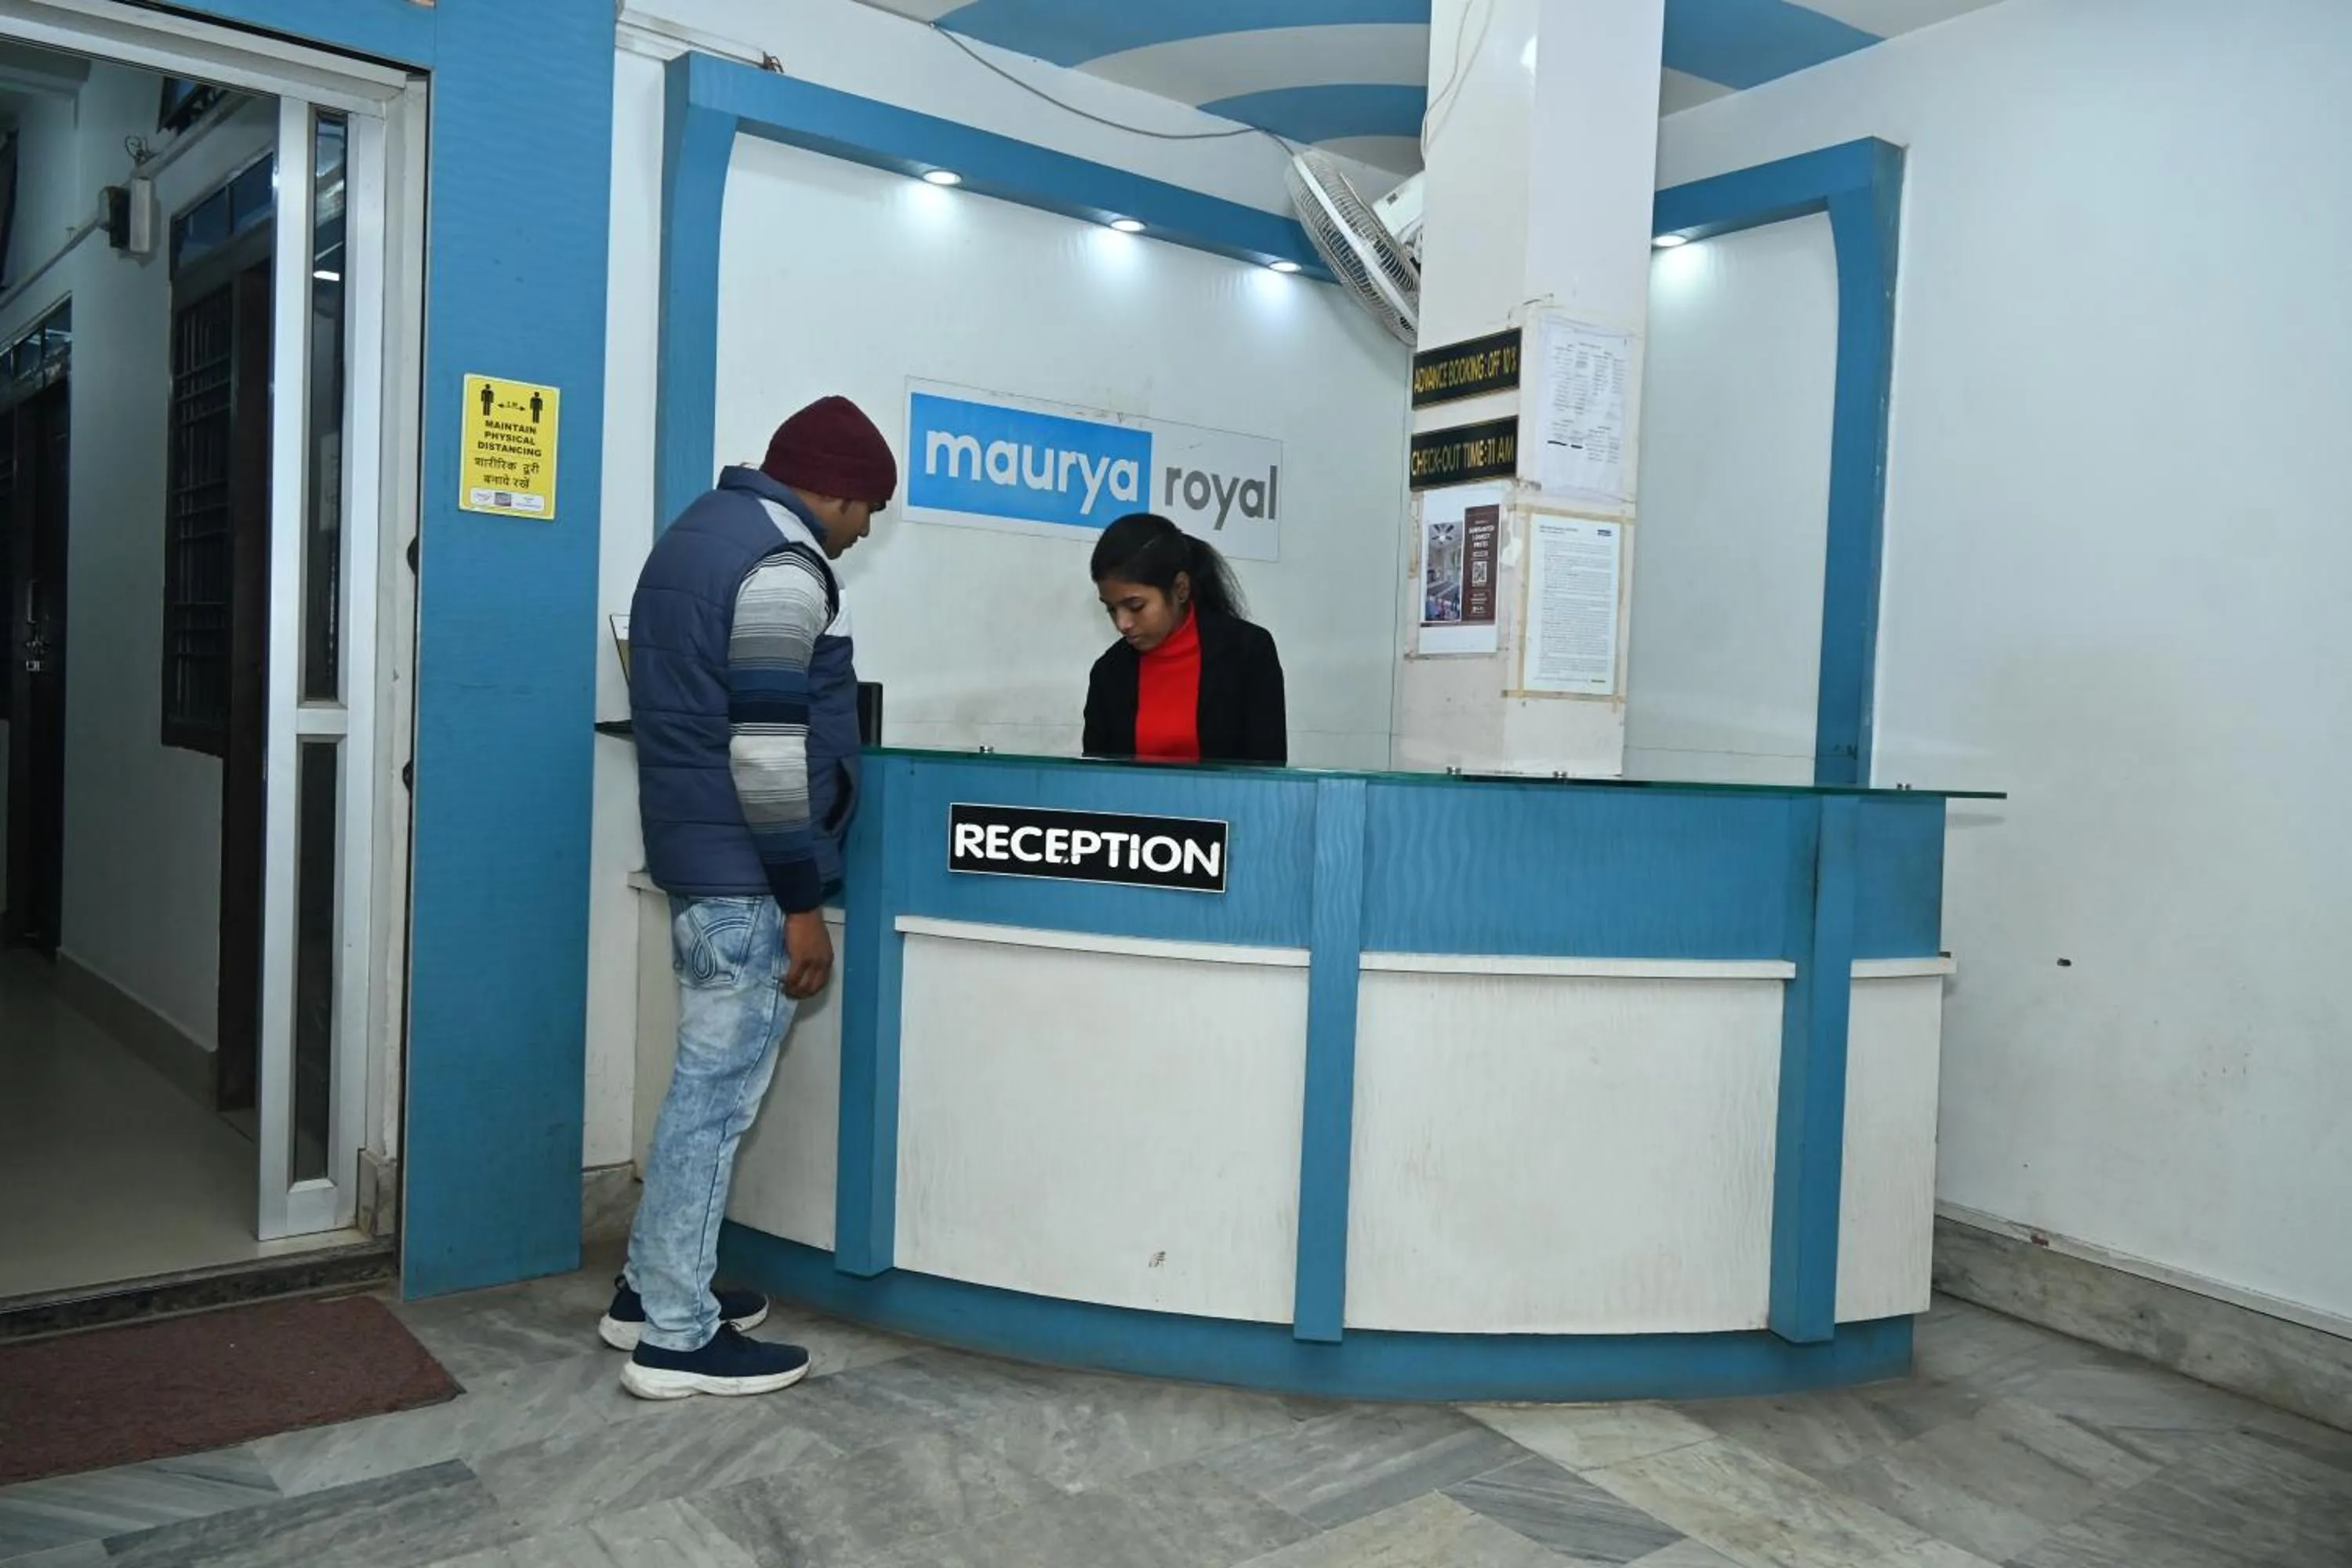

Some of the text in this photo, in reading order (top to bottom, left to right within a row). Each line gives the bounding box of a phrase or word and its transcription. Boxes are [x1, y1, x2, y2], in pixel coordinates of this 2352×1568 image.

[1414, 361, 1447, 394] ADVANCE
[484, 430, 535, 445] PHYSICAL
[485, 419, 536, 435] MAINTAIN
[477, 440, 542, 457] DISTANCING
[1410, 442, 1461, 477] CHECK-OUT
[925, 430, 1278, 531] maurya royal
[954, 822, 1221, 877] RECEPTION
